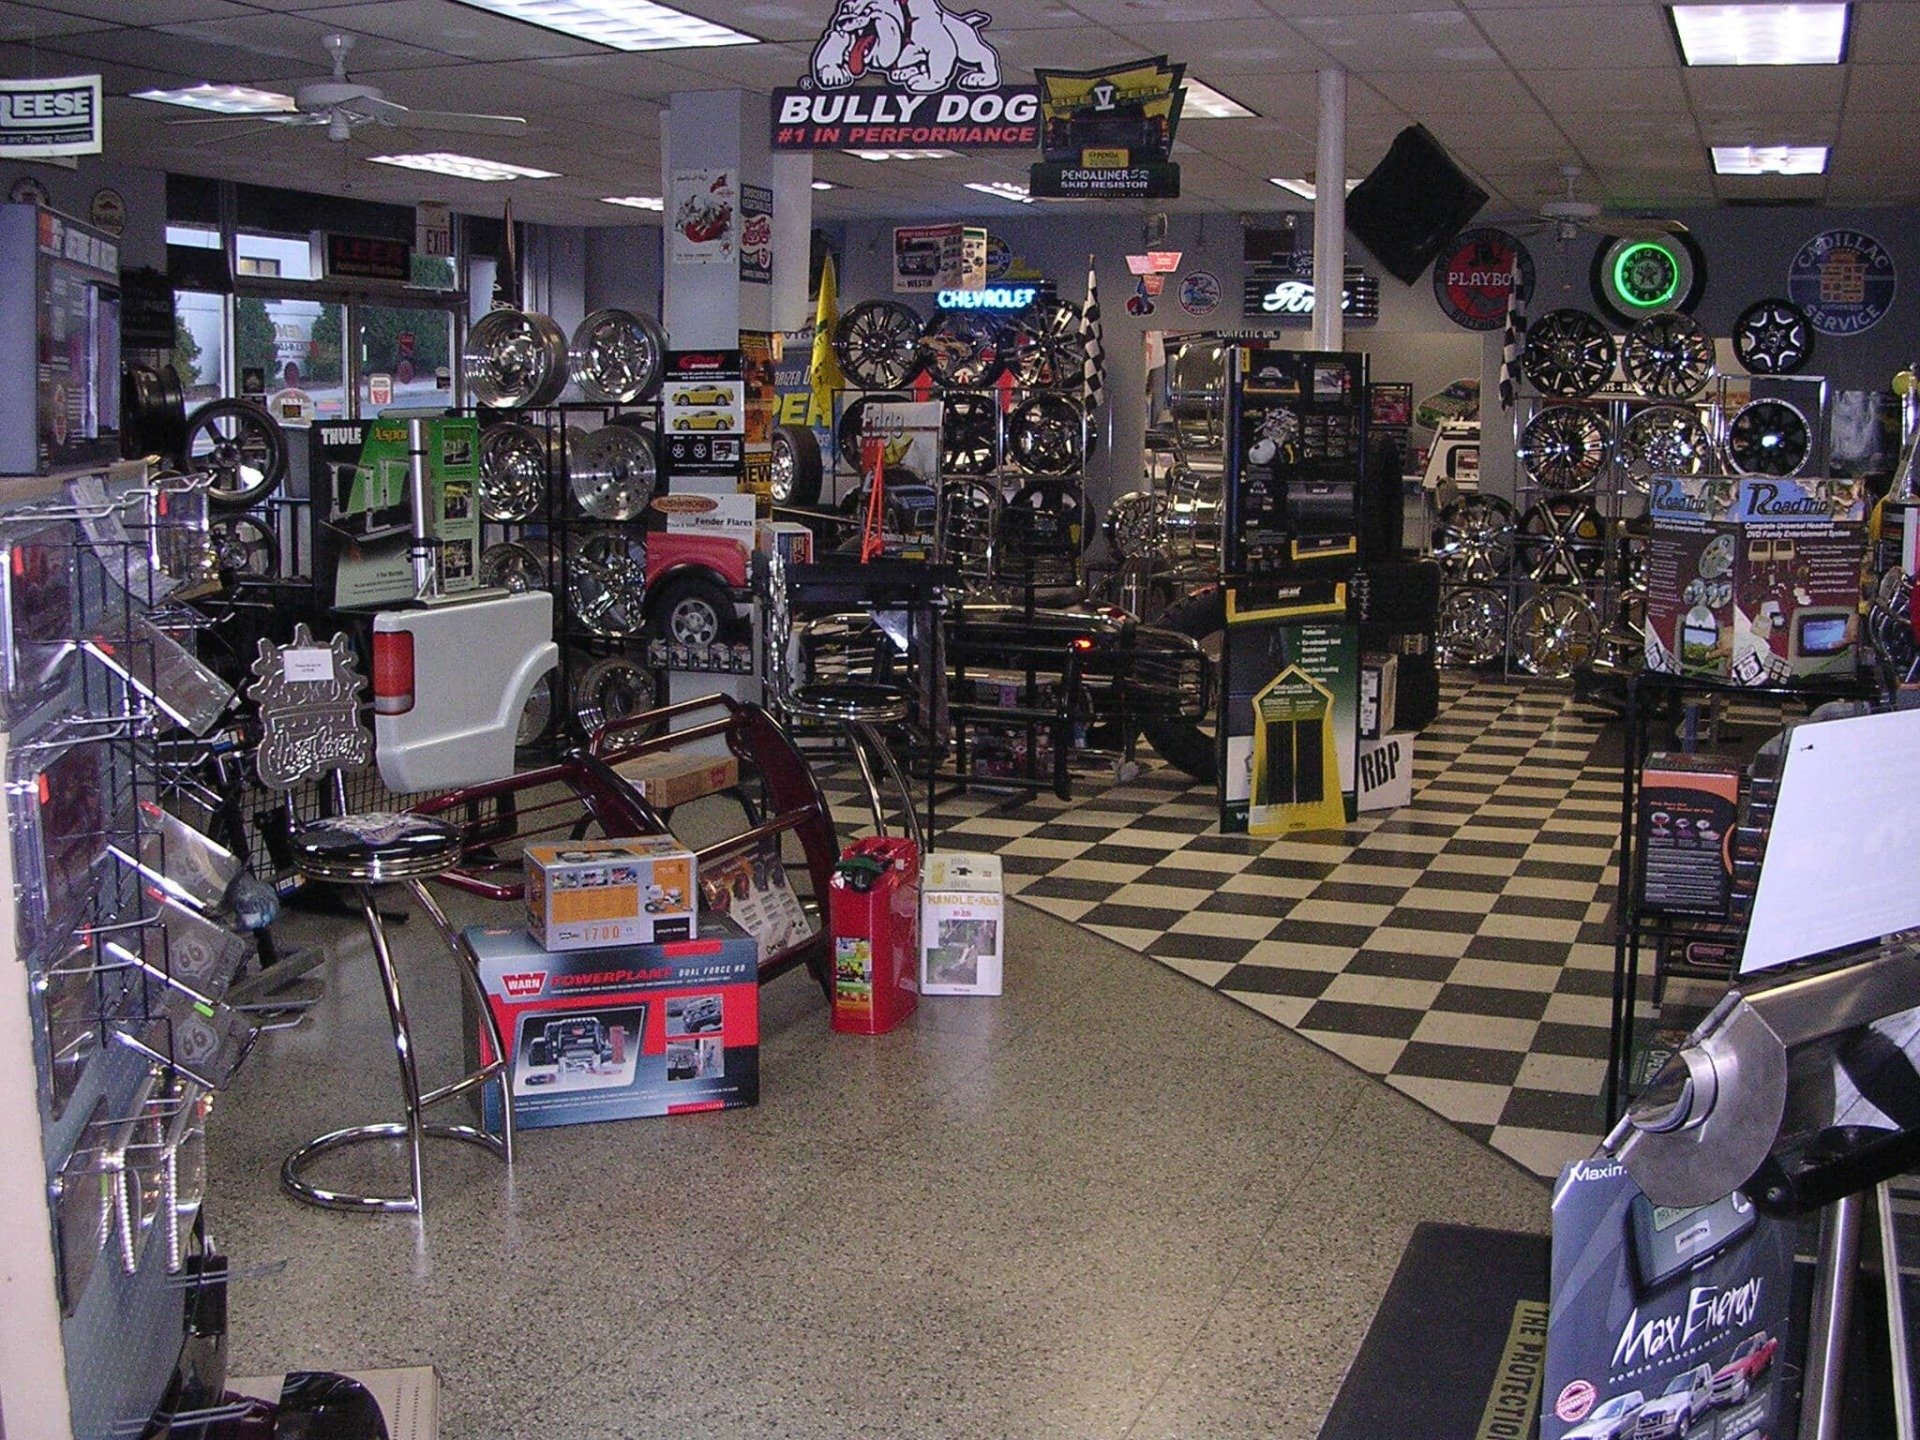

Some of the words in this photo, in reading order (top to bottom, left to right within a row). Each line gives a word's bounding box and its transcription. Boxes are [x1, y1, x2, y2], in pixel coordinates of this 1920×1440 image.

[779, 94, 927, 123] BULLY
[936, 93, 1037, 123] DOG
[777, 128, 804, 142] #1
[814, 127, 839, 142] IN
[849, 126, 1035, 142] PERFORMANCE
[1061, 170, 1129, 180] PENDALINER
[427, 229, 449, 255] EXIT
[1798, 233, 1889, 269] CADILLAC
[1448, 272, 1515, 286] PLAYBO
[937, 288, 1036, 309] CHEVROLET
[1262, 281, 1351, 312] For
[1803, 304, 1880, 331] SERVICE
[321, 427, 362, 445] THULE
[1747, 483, 1830, 516] RoadTrip
[695, 517, 725, 527] Fender
[727, 517, 753, 527] Flares
[1777, 522, 1805, 530] Universal
[1747, 530, 1761, 538] DVD
[1762, 530, 1783, 539] Family
[1784, 530, 1827, 538] Entertainment
[1828, 530, 1851, 539] System
[1360, 740, 1401, 794] RBP
[583, 925, 621, 941] 1700
[508, 977, 540, 991] WARN
[703, 965, 732, 976] FORCE
[1520, 1308, 1549, 1336] THE
[1612, 1307, 1681, 1366] Max
[1682, 1276, 1764, 1348] Energy
[1608, 1365, 1653, 1384] POWER
